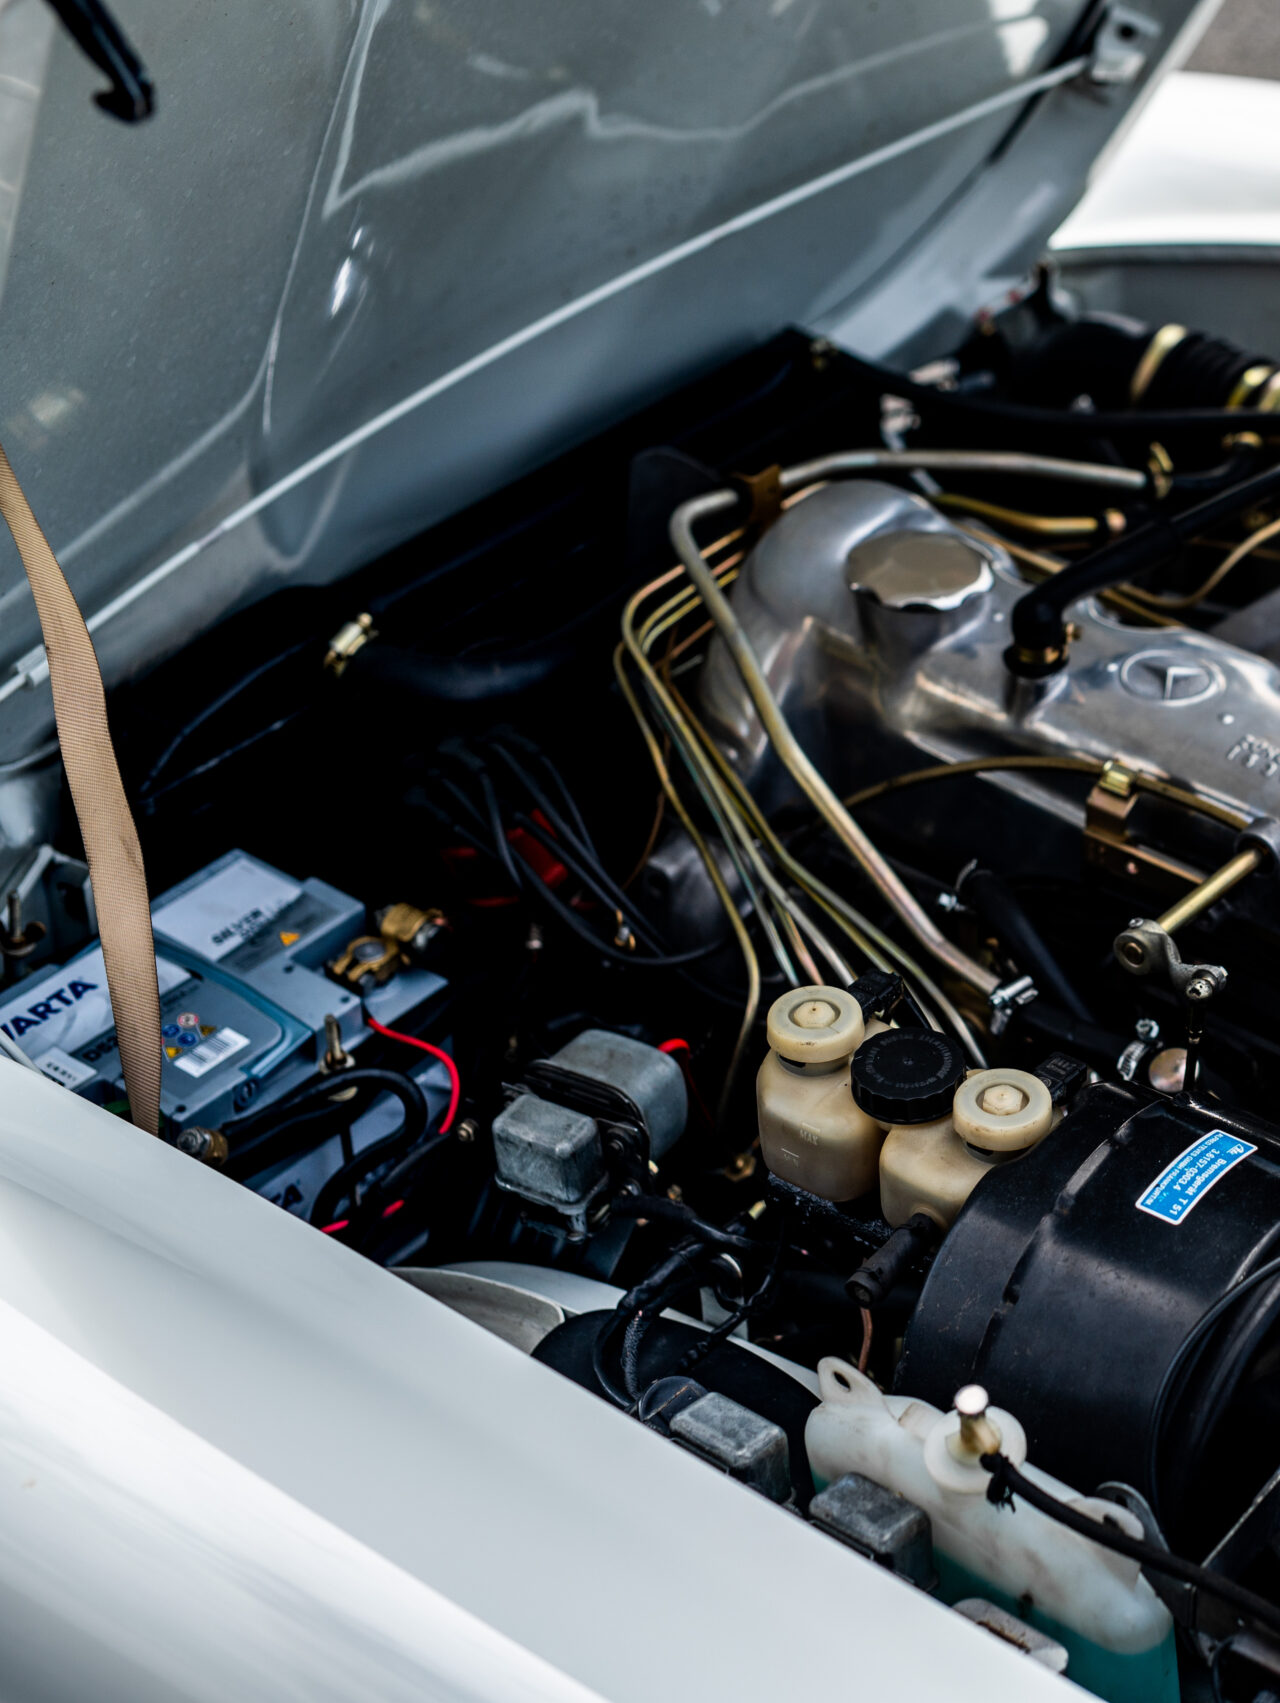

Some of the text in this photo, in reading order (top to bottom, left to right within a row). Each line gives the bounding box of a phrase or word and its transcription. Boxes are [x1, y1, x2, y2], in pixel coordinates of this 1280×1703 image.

[1169, 1158, 1227, 1216] Bremsgerät T 51
